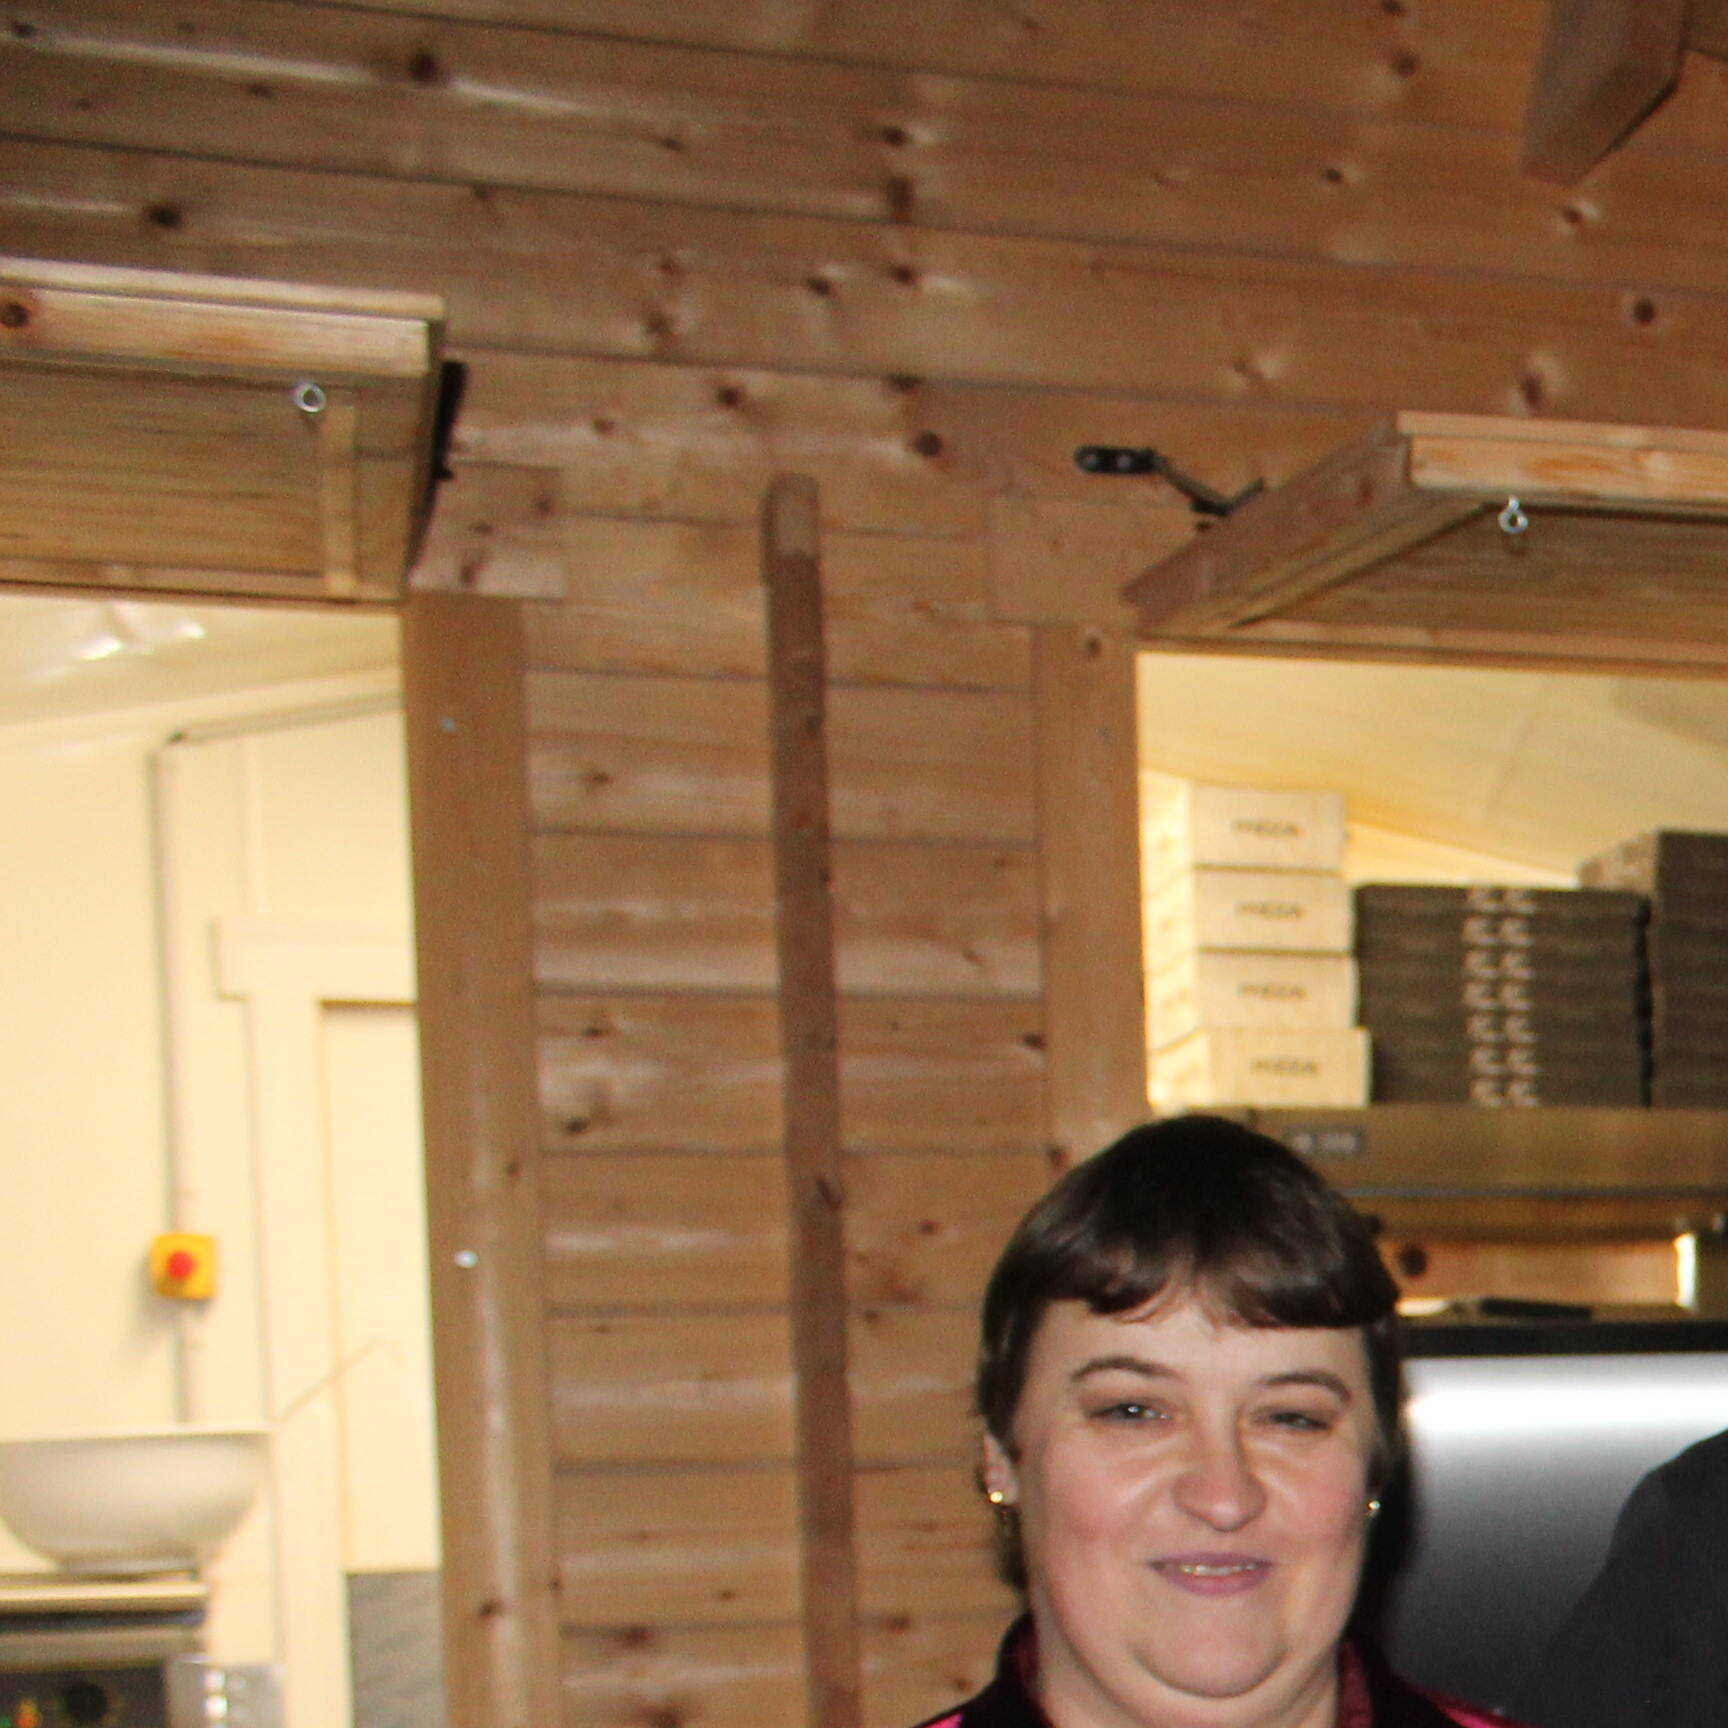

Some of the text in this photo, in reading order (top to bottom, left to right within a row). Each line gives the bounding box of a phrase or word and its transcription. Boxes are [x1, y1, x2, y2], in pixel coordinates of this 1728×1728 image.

[1231, 819, 1300, 838] PIZZA
[1235, 902, 1304, 919] PIZZA
[1238, 982, 1308, 1001] PIZZA
[1250, 1057, 1320, 1077] PIZZA
